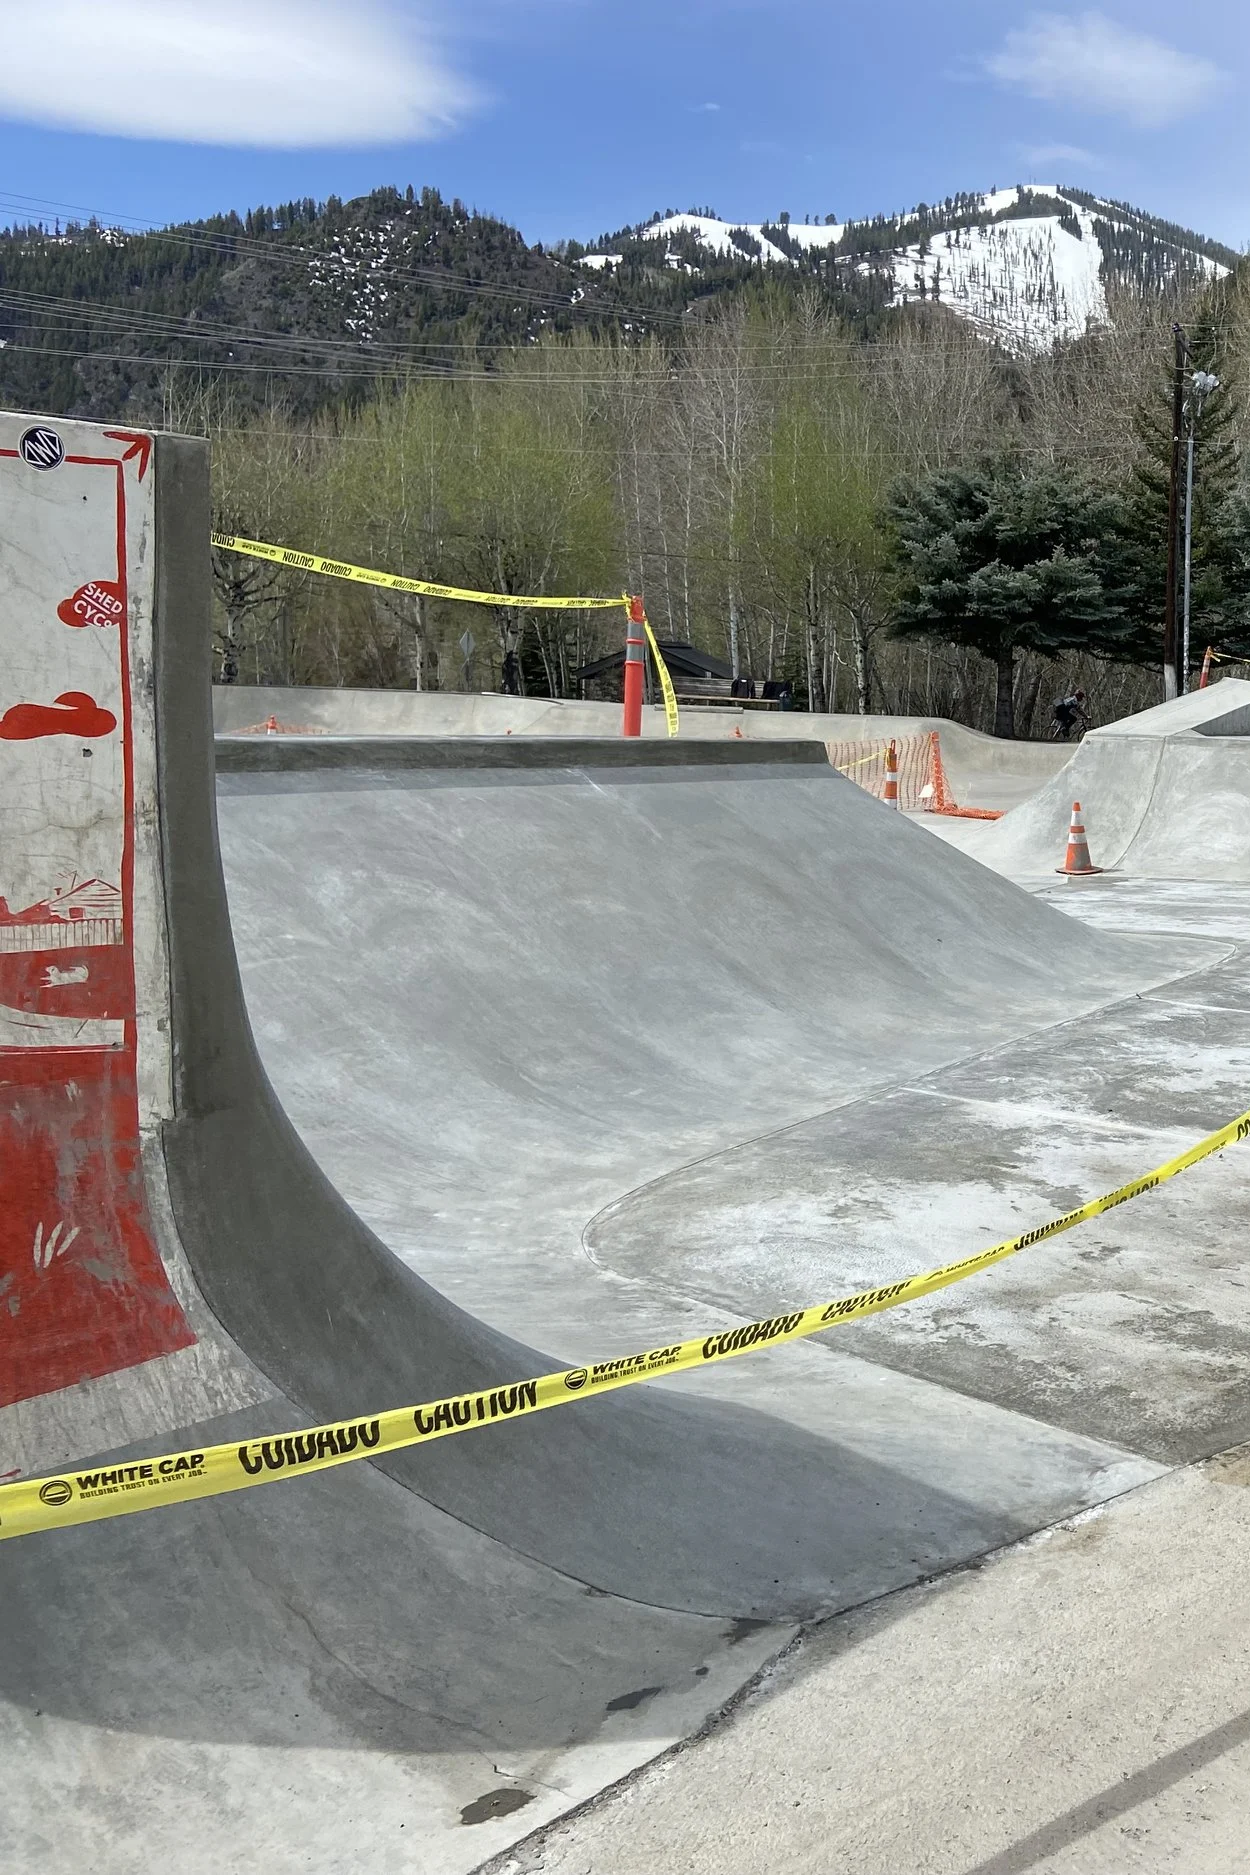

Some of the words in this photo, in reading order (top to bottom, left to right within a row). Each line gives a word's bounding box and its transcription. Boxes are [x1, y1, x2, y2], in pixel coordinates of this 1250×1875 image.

[282, 550, 315, 569] CAUTION
[320, 560, 352, 577] CUIDADO
[84, 582, 123, 614] SHED
[390, 578, 421, 592] CAUTION
[702, 1311, 805, 1360] CUIDADO
[591, 1371, 619, 1384] BUILDING
[619, 1367, 637, 1378] TRUST
[647, 1359, 665, 1370] EVERY
[592, 1353, 645, 1375] WHITE
[646, 1345, 681, 1363] CAP
[413, 1380, 538, 1436] CAUTION
[237, 1420, 382, 1475] CUIDADO
[76, 1462, 154, 1490] WHITE
[154, 1453, 205, 1475] CAP
[79, 1486, 119, 1500] BUILDING
[120, 1482, 147, 1494] TRUST
[148, 1478, 160, 1487] ON
[161, 1472, 186, 1484] EVERY
